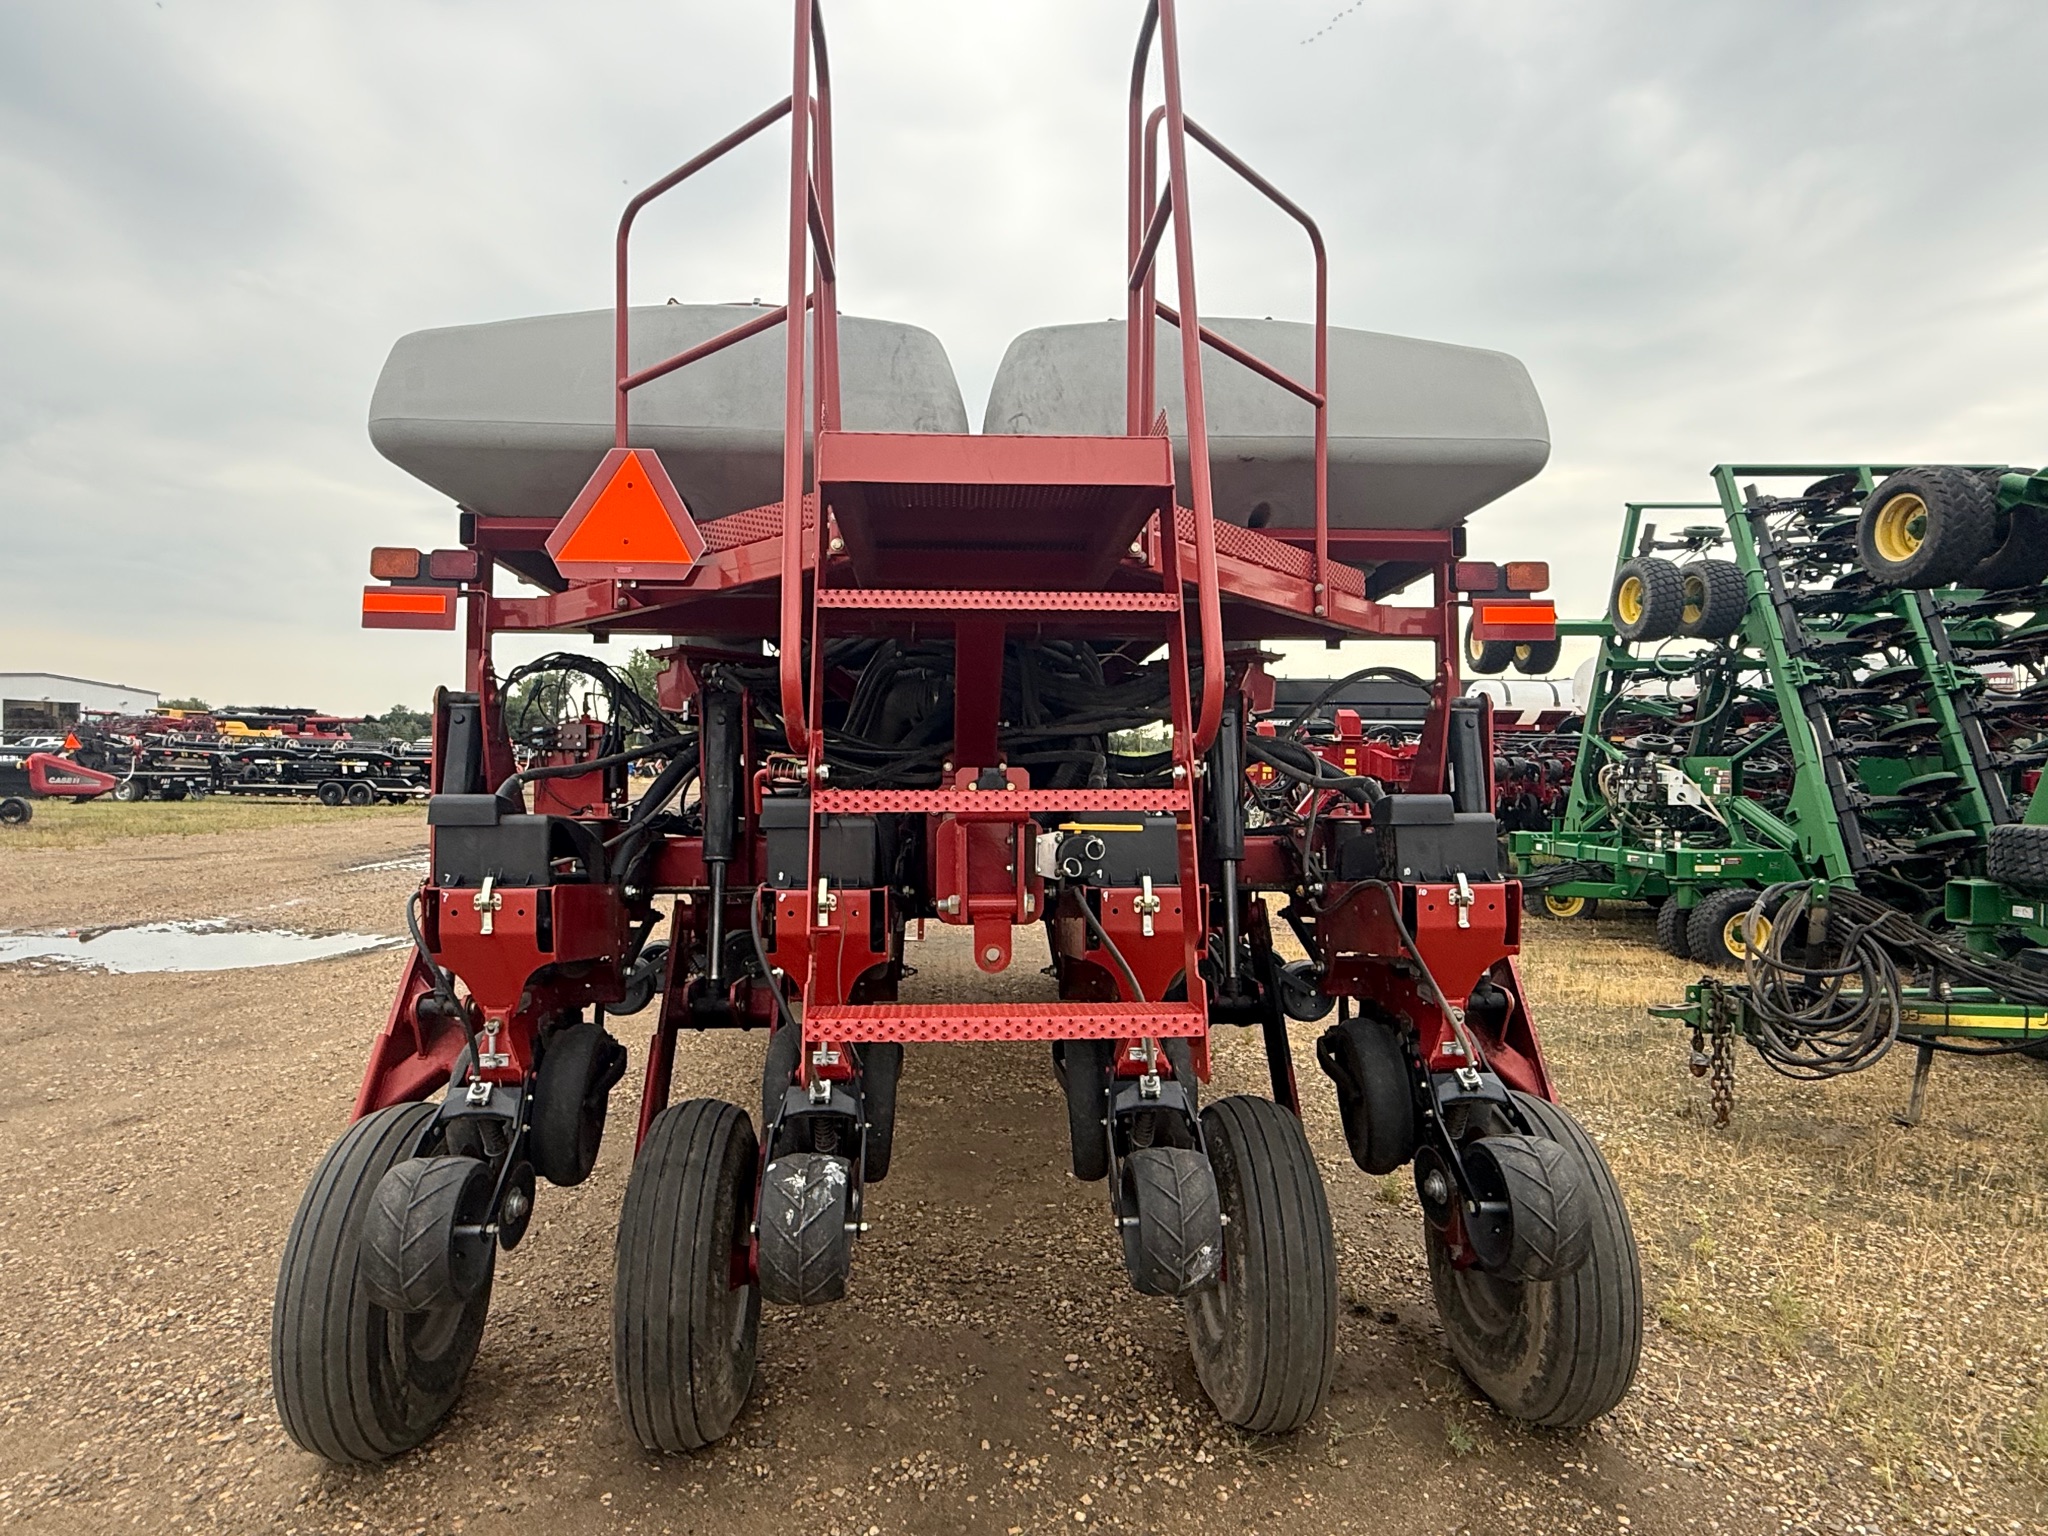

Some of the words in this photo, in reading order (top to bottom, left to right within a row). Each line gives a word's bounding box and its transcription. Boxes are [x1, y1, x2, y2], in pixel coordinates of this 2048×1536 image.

[444, 873, 451, 883] 7
[1102, 890, 1108, 902] 9
[1418, 888, 1428, 896] 10
[442, 892, 449, 903] 7
